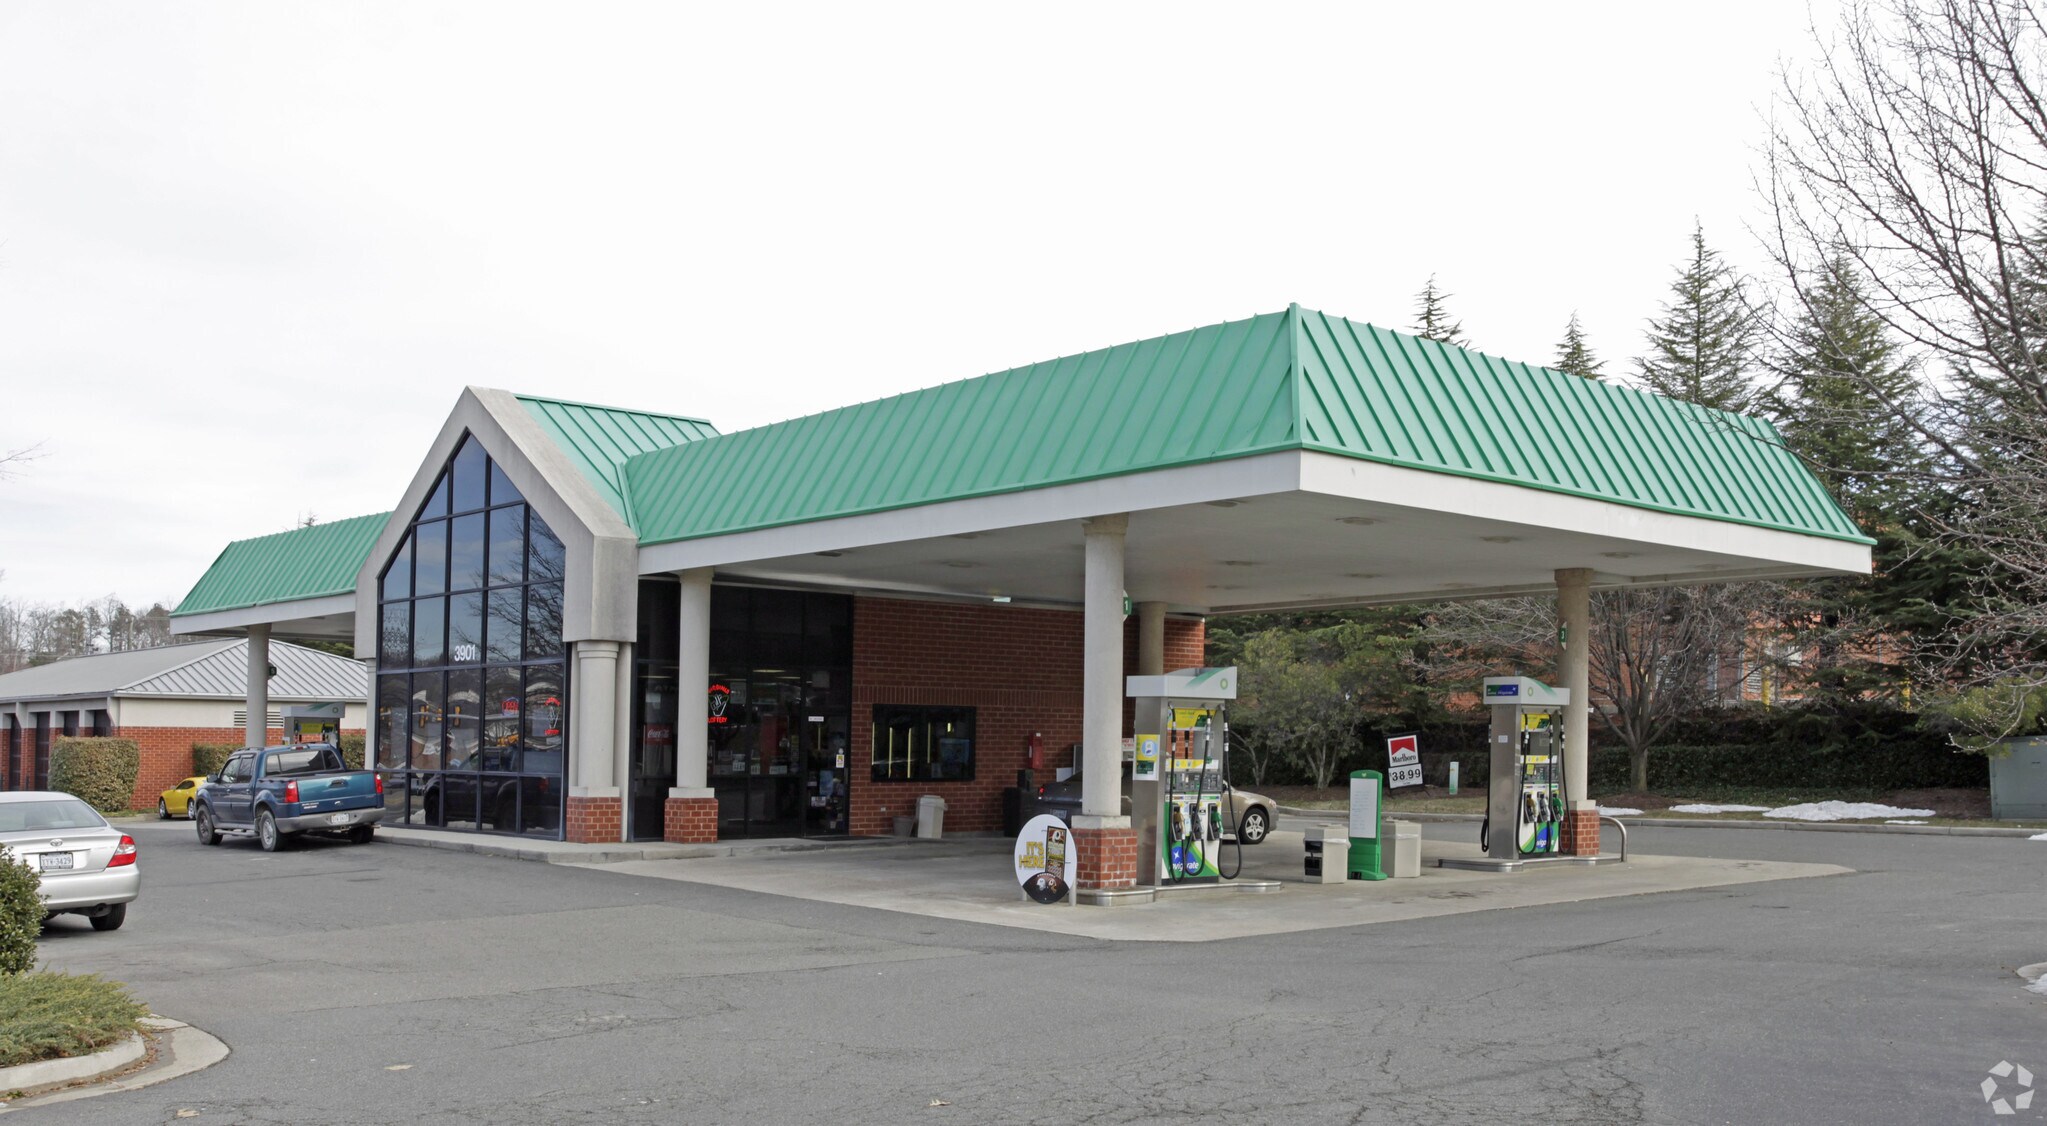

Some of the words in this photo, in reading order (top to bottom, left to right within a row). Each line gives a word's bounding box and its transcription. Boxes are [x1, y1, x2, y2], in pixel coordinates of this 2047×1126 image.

[454, 644, 476, 661] 3901
[1392, 753, 1417, 764] Marlboro
[1018, 855, 1045, 869] HERE
